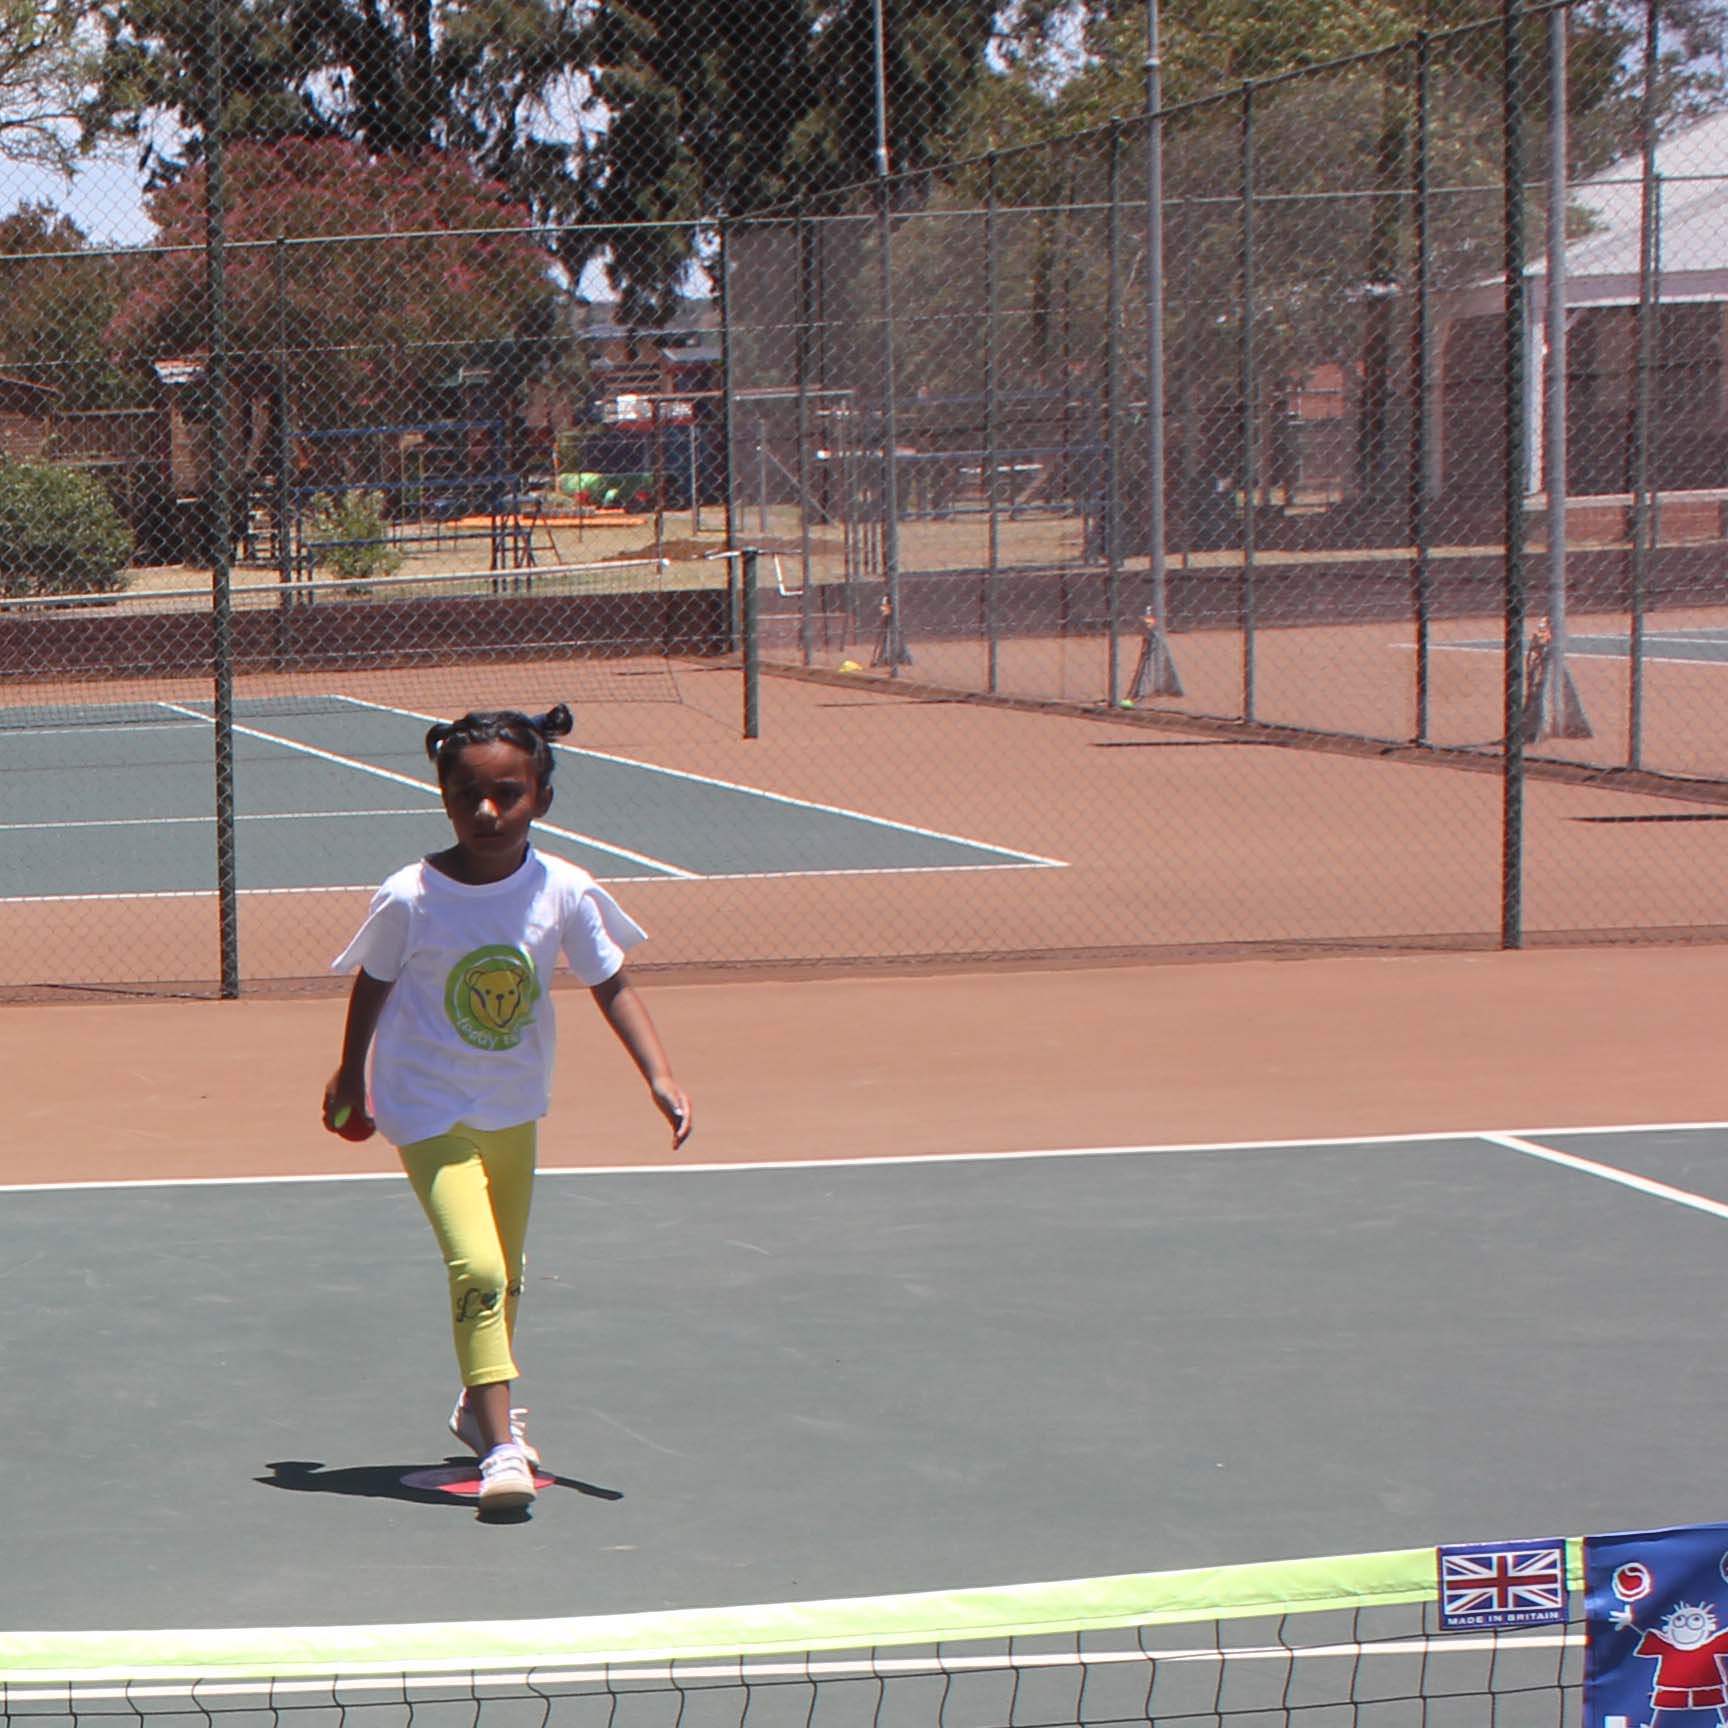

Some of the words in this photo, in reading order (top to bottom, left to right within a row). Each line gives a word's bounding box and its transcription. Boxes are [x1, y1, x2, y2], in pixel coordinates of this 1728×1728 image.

[1447, 1615, 1484, 1625] MADE
[1488, 1614, 1502, 1623] IN
[1507, 1611, 1559, 1622] BRITAIN
